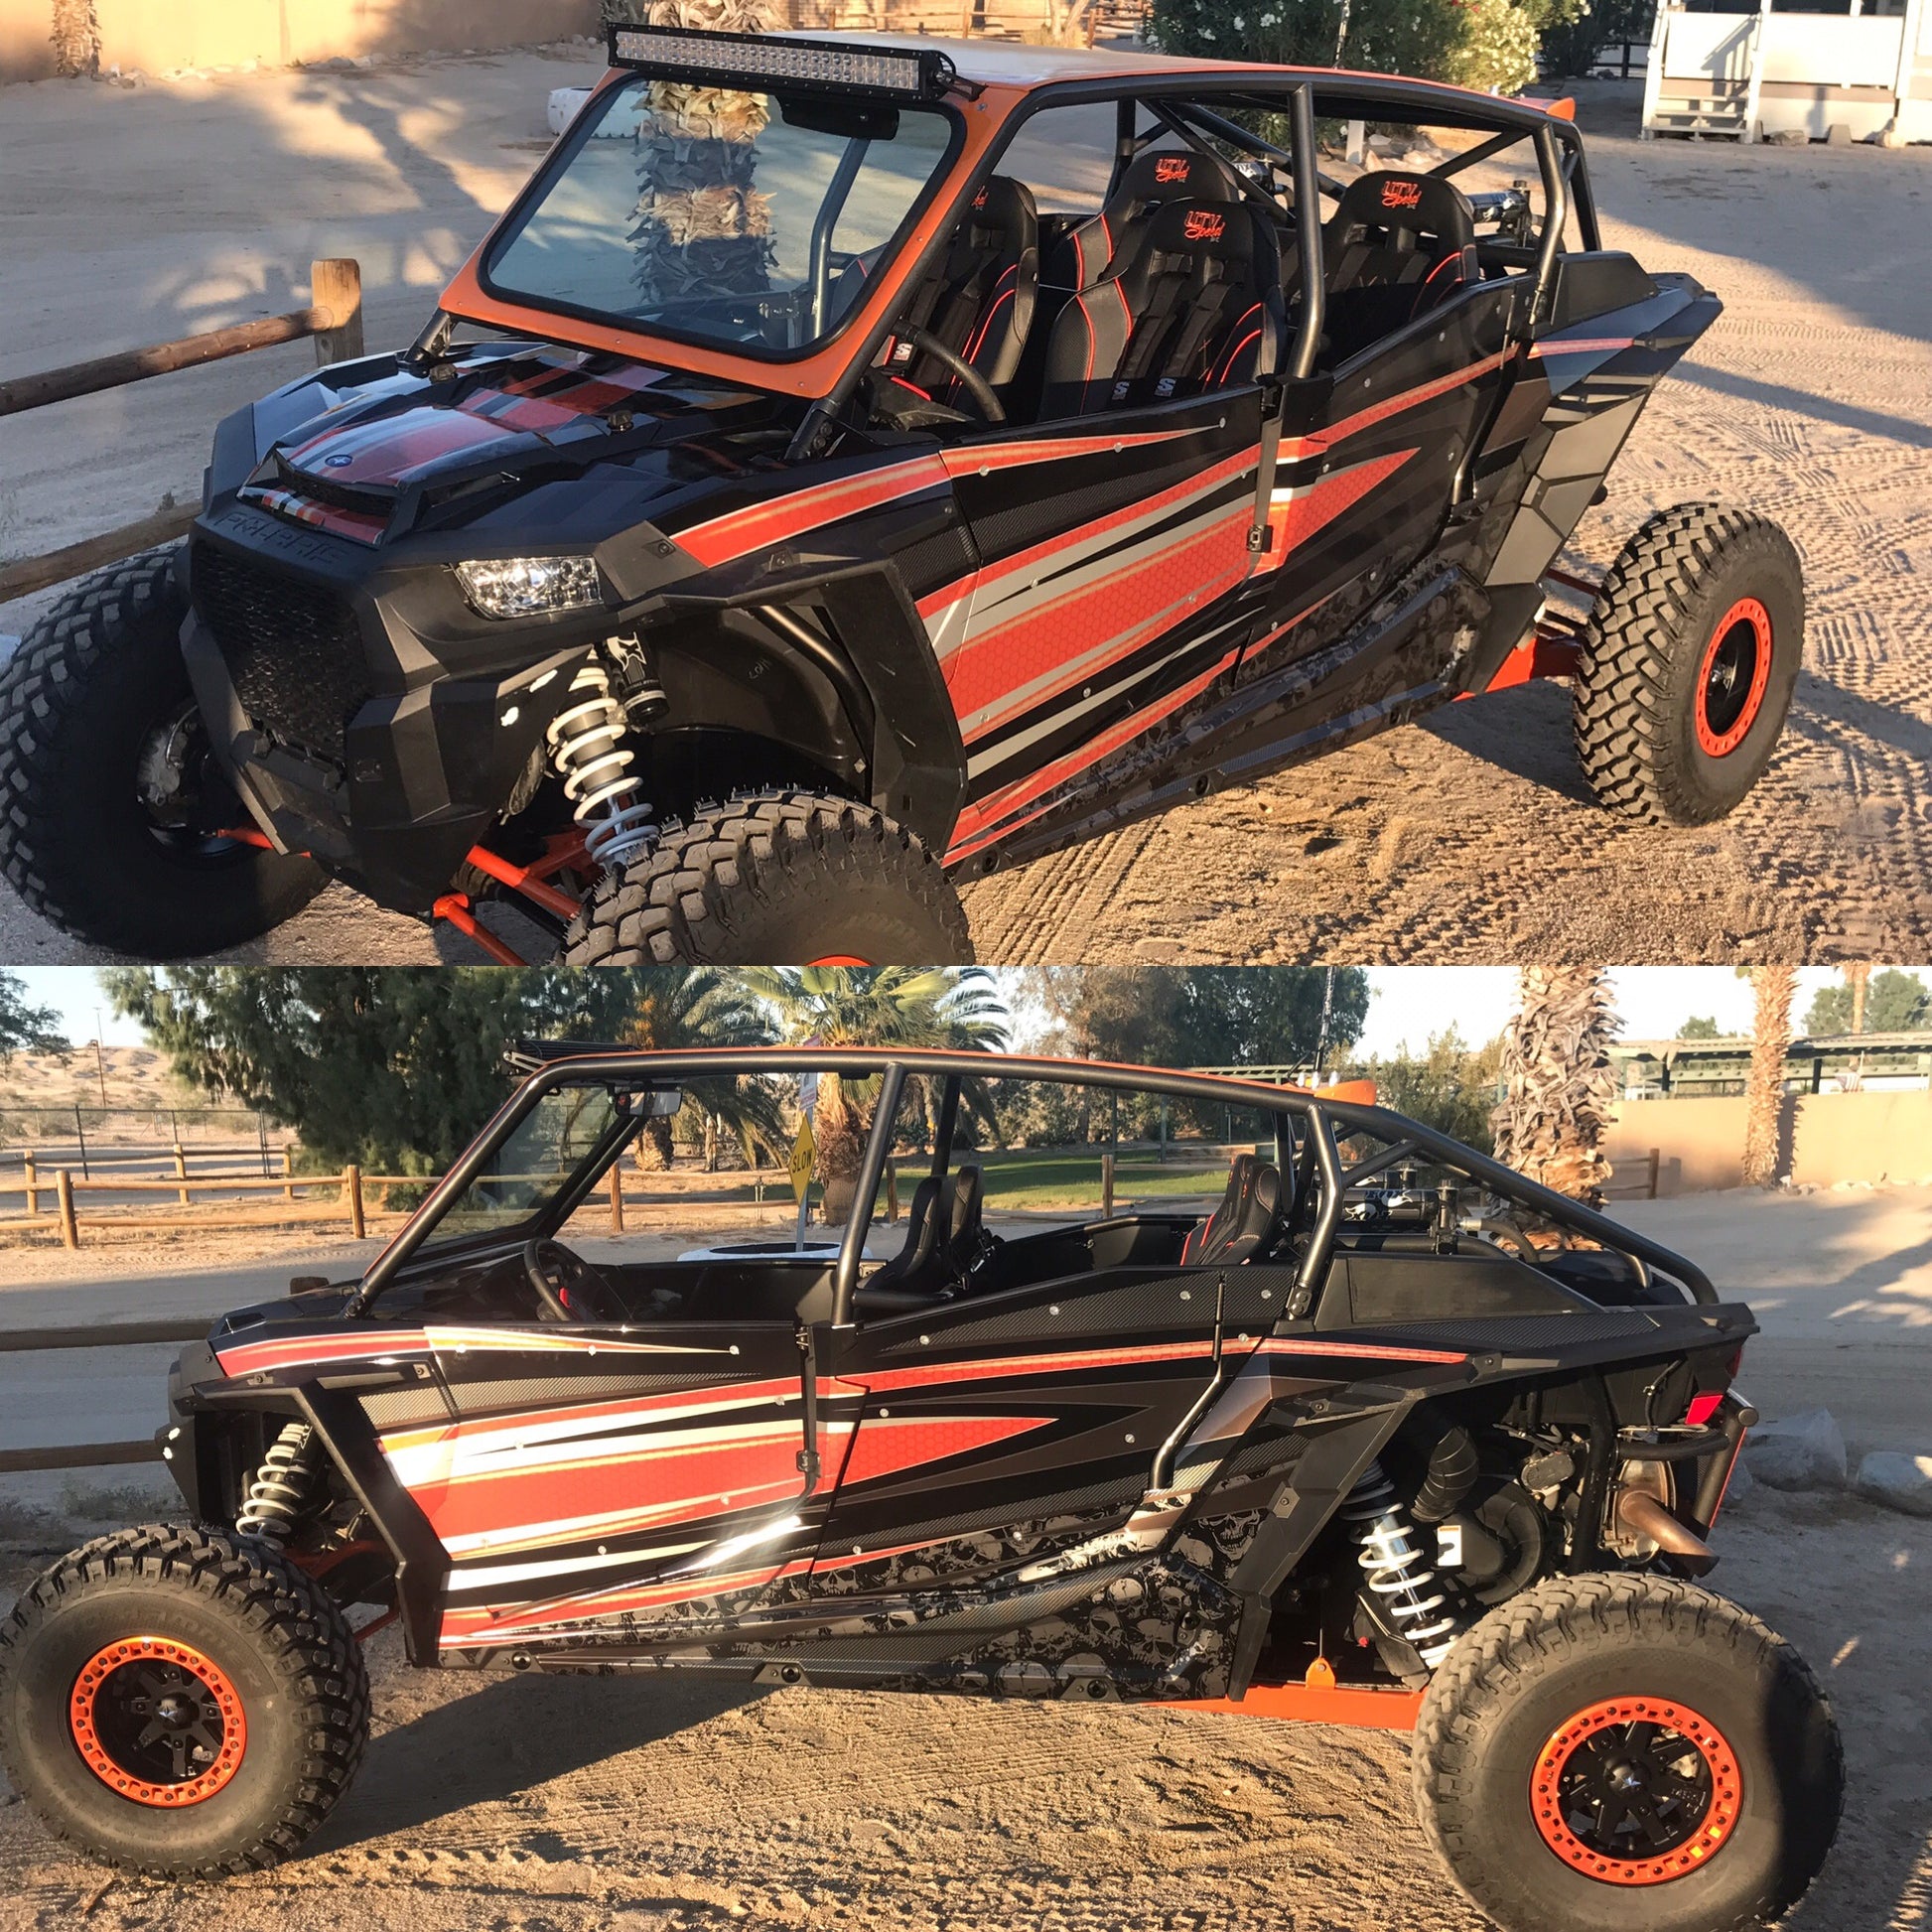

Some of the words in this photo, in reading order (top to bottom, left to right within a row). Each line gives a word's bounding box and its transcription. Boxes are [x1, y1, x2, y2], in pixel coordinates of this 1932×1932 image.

[1184, 210, 1222, 228] UTV
[1184, 221, 1226, 241] Speed
[792, 1148, 813, 1173] SLOW
